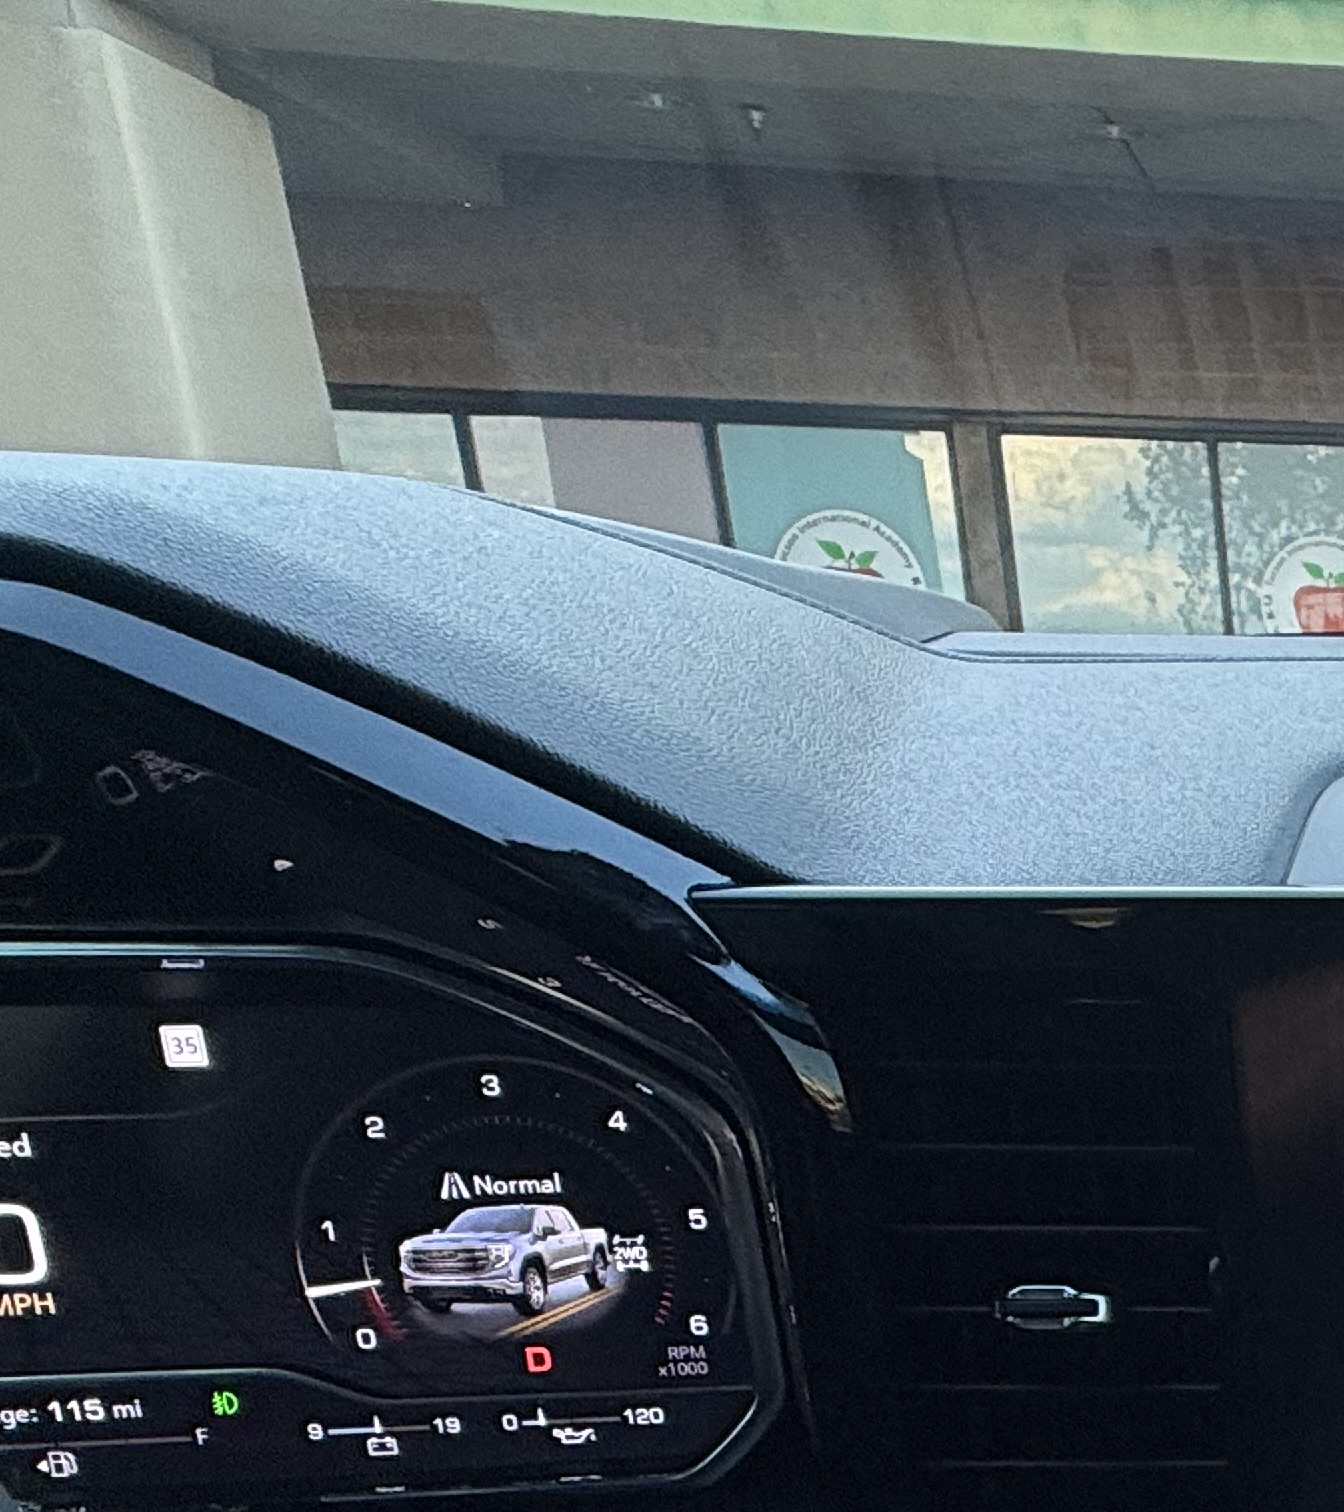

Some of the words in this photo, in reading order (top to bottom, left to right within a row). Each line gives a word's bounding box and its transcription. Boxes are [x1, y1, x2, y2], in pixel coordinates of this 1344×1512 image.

[170, 1036, 198, 1056] 35
[480, 1075, 501, 1097] 3
[365, 1117, 386, 1139] 2
[607, 1111, 628, 1132] 4
[472, 1171, 562, 1196] Normal
[688, 1208, 708, 1230] 5
[320, 1221, 337, 1241] 1
[613, 1245, 649, 1261] 2WD
[689, 1315, 709, 1337] 6
[356, 1328, 378, 1350] 0
[525, 1346, 552, 1373] D
[668, 1345, 707, 1360] RPM
[658, 1360, 708, 1377] x1000
[47, 1399, 105, 1423] 115
[112, 1399, 143, 1419] mi
[623, 1407, 664, 1425] 120
[307, 1424, 324, 1440] 9
[432, 1417, 461, 1434] 19
[502, 1414, 518, 1431] 0
[195, 1427, 209, 1446] F
